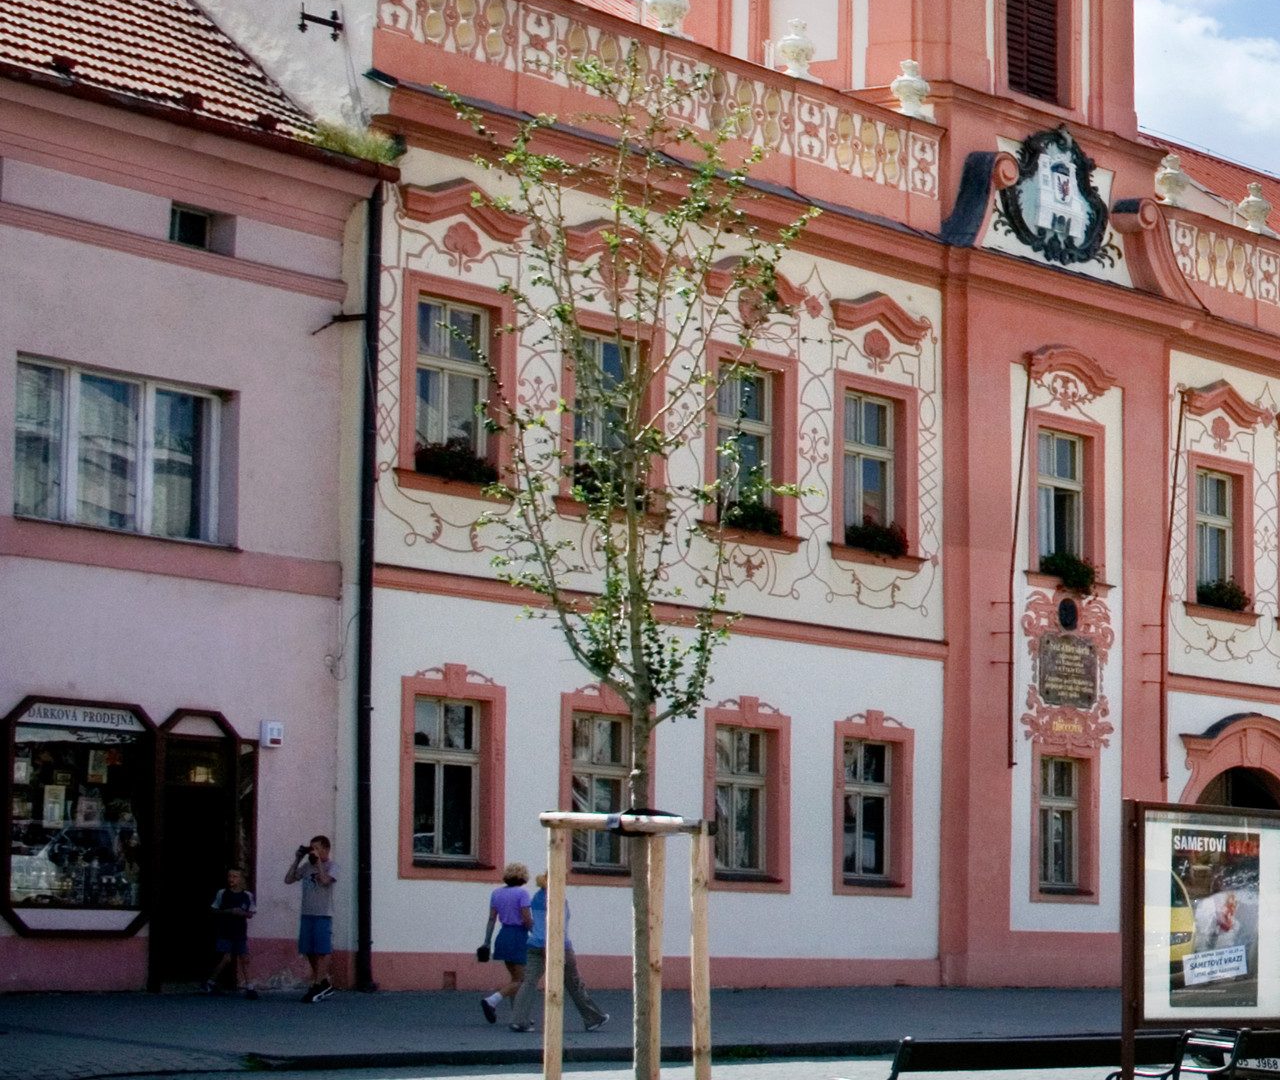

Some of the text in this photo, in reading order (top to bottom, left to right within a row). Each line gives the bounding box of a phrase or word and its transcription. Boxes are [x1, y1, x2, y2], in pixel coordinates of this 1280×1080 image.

[28, 706, 134, 726] DÁRKOVÁ PRODEJNA
[1174, 834, 1227, 852] SAMETOVÍ
[1256, 1058, 1279, 1070] 3968
